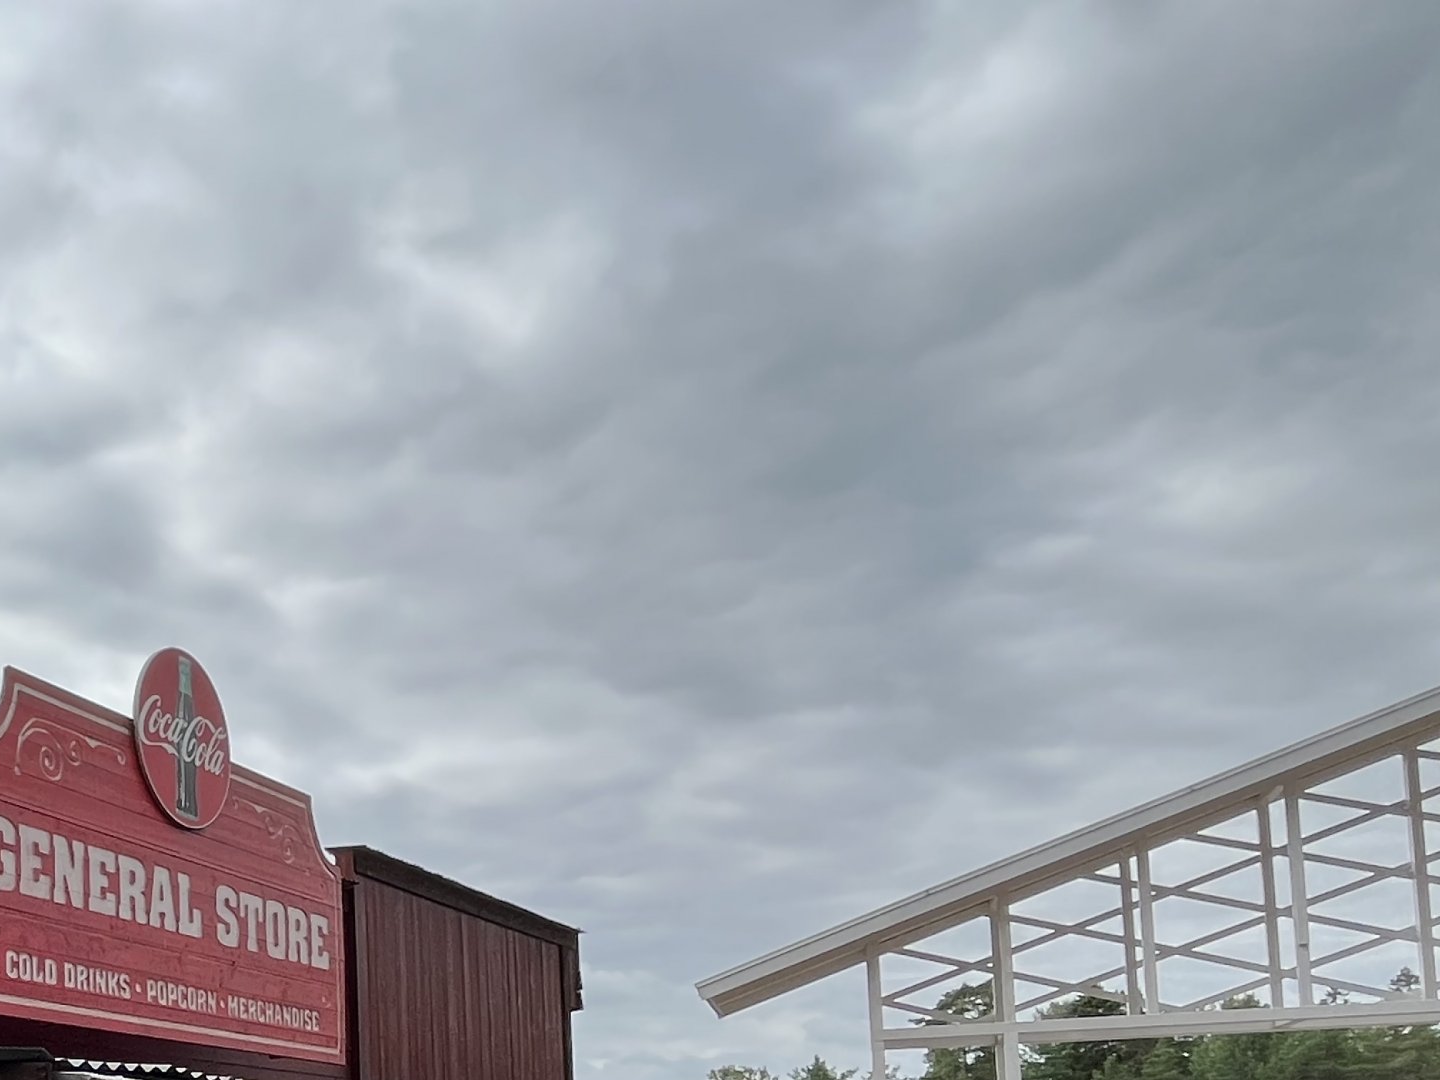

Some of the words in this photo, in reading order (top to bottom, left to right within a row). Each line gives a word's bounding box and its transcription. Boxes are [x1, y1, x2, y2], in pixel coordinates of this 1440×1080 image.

[138, 694, 226, 776] Coca-Cola
[215, 884, 331, 970] STORE
[5, 950, 57, 985] COLD
[64, 962, 131, 999] DRINKS
[147, 979, 218, 1014] POPCORN
[228, 995, 320, 1031] MERCHANDISE
